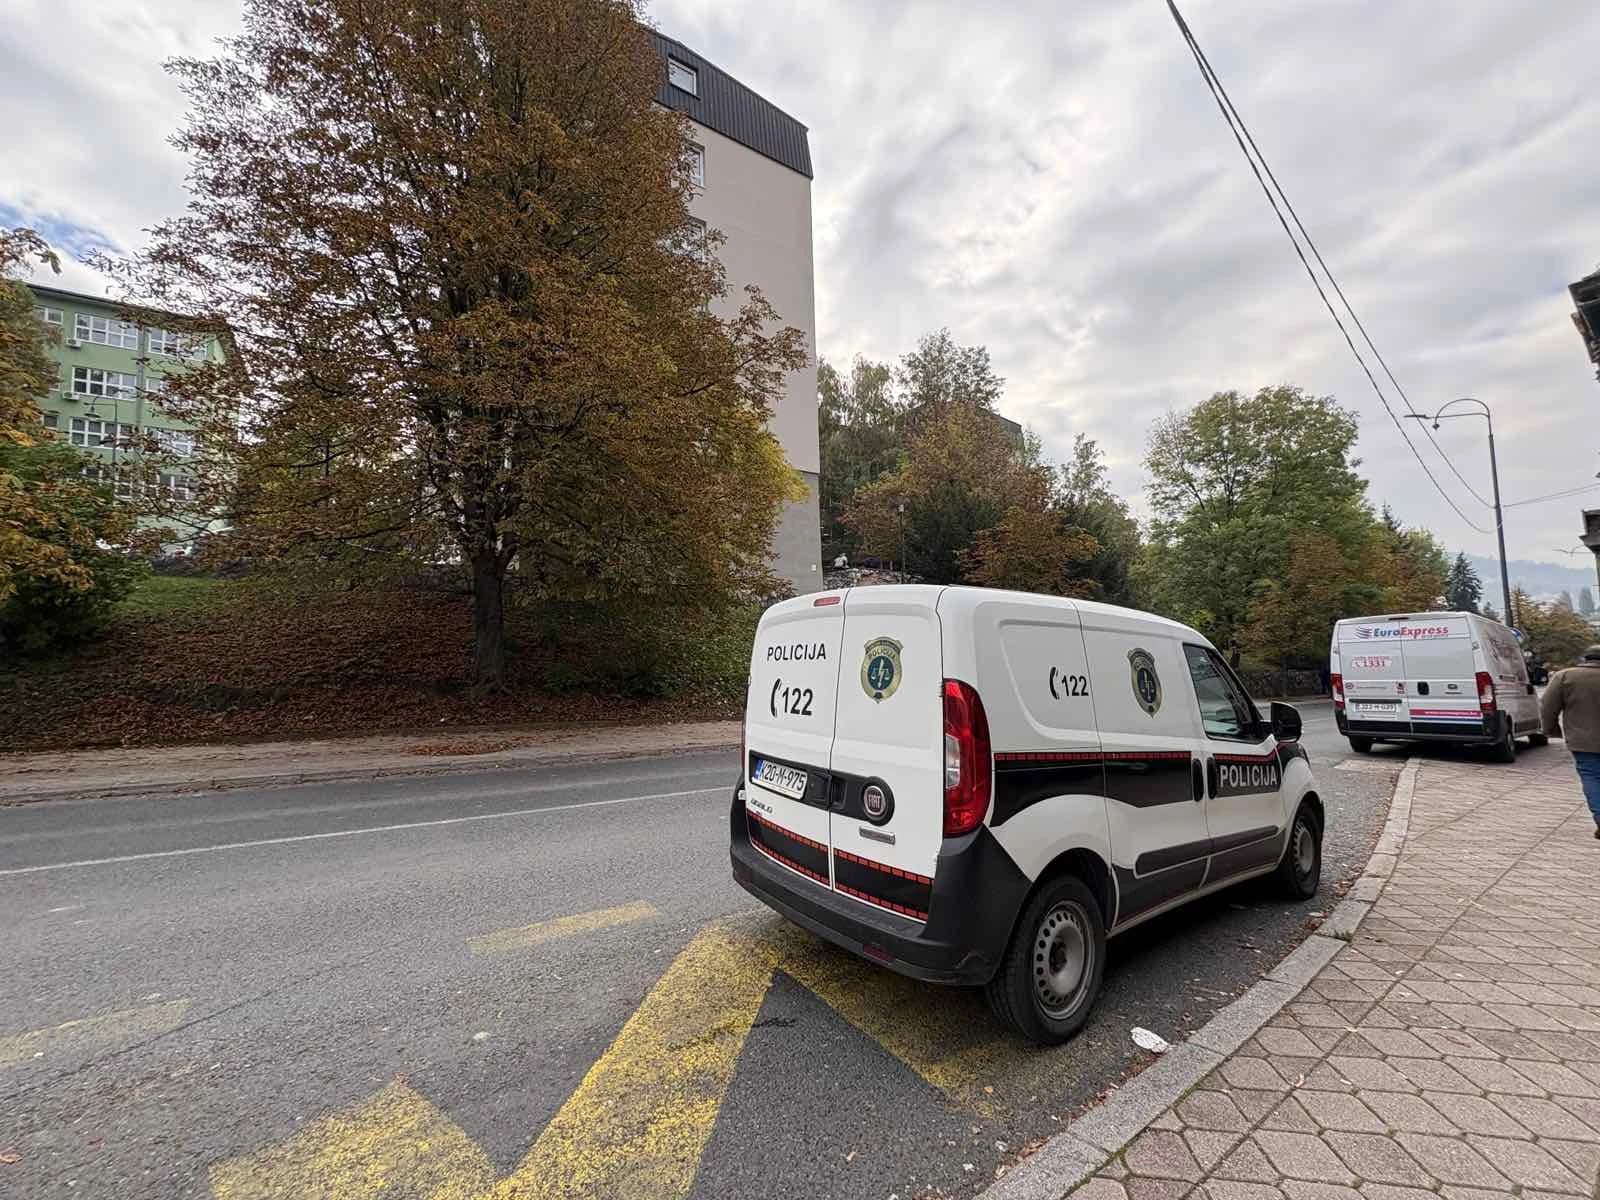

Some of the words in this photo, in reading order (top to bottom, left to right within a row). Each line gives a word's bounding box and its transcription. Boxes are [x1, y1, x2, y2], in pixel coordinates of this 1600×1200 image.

[1373, 626, 1448, 638] EuroExpress
[767, 643, 826, 661] POLICIJA
[1061, 675, 1089, 697] 122
[782, 687, 813, 716] 122
[1220, 764, 1278, 788] POLICIJA
[868, 793, 881, 808] FIAT
